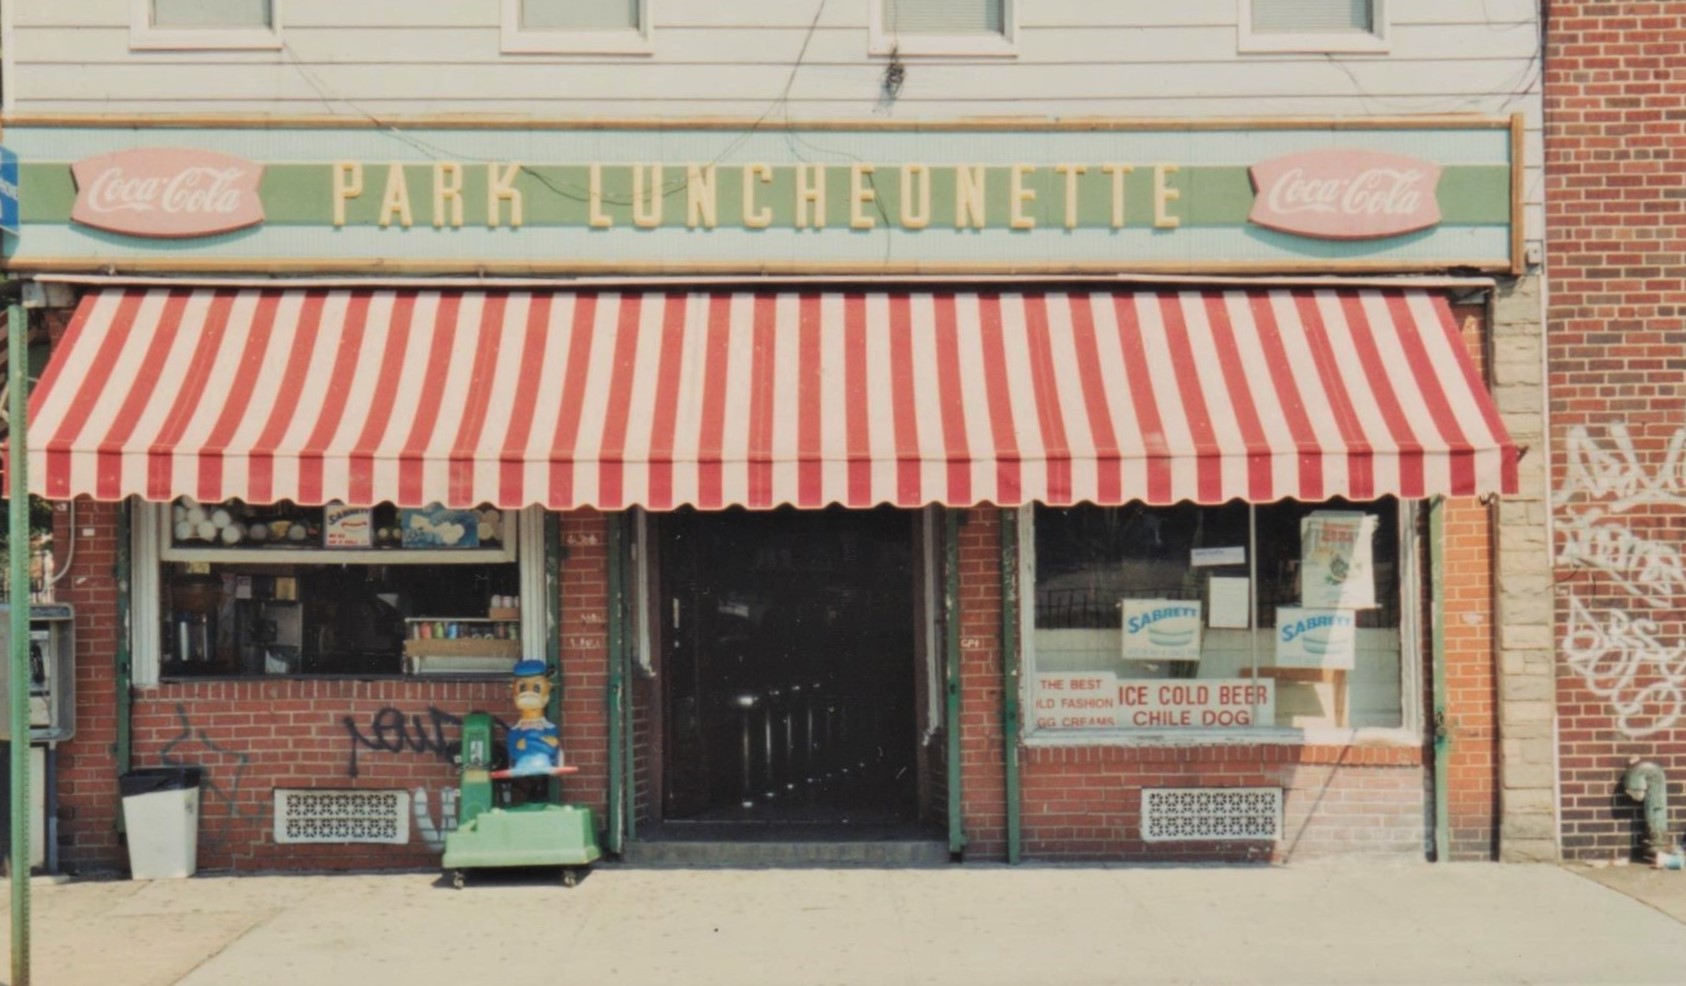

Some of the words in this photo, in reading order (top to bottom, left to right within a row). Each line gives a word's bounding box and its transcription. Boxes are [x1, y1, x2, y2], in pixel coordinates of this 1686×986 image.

[331, 162, 523, 228] PARK
[588, 163, 1181, 228] LUNCHEONETTE
[1128, 607, 1196, 634] SABRETT
[1282, 617, 1350, 642] SABRETT
[1040, 680, 1064, 690] THE
[1070, 680, 1102, 690] BEST
[1061, 698, 1113, 709] FASHION
[1119, 686, 1148, 706] ICE
[1159, 685, 1209, 706] COLD
[1220, 686, 1268, 706] BEER
[1062, 716, 1116, 727] CREAMS
[1133, 711, 1191, 726] CHILE
[1203, 711, 1252, 726] DOG
